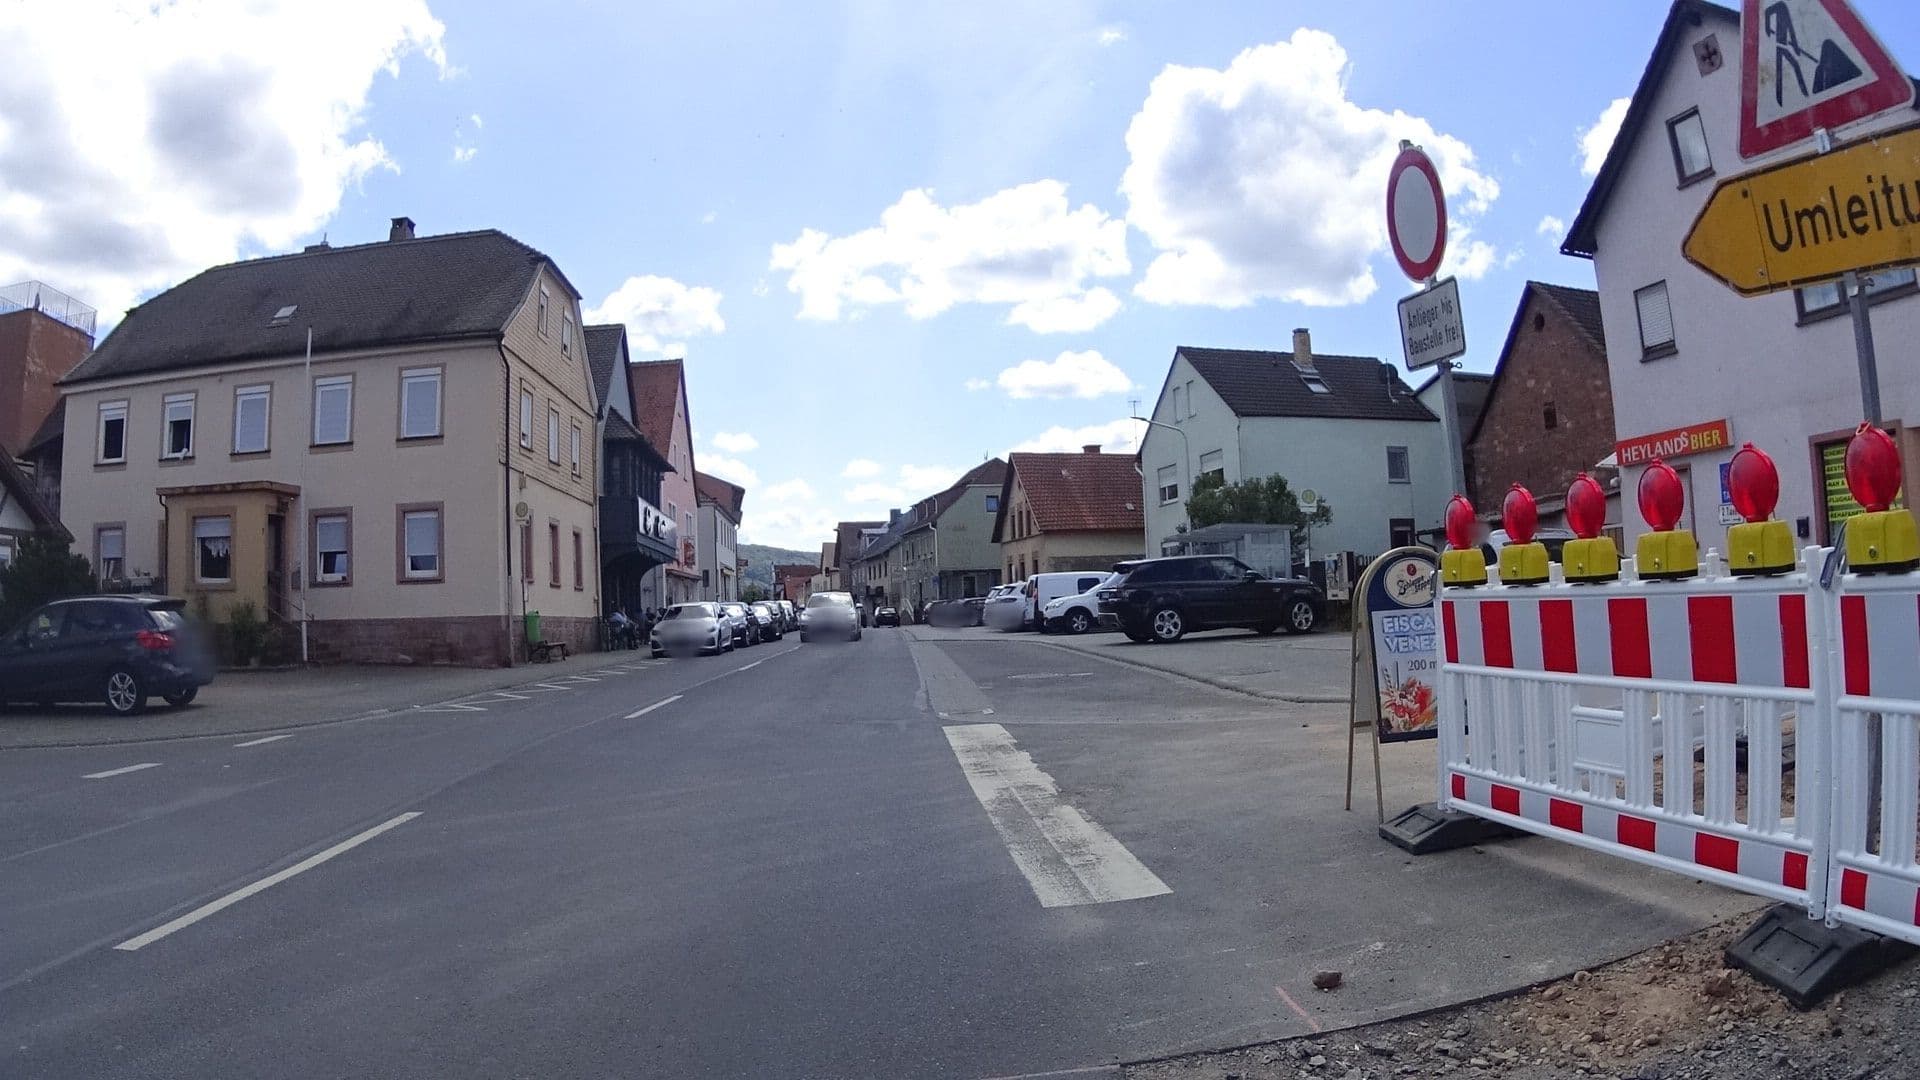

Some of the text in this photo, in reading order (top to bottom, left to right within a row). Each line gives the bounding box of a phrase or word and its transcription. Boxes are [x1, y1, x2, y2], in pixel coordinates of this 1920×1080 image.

[1408, 296, 1453, 330] Anlieger bis
[1409, 321, 1460, 355] Baustelle frei
[1690, 429, 1721, 450] BIER
[1408, 660, 1427, 671] 200
